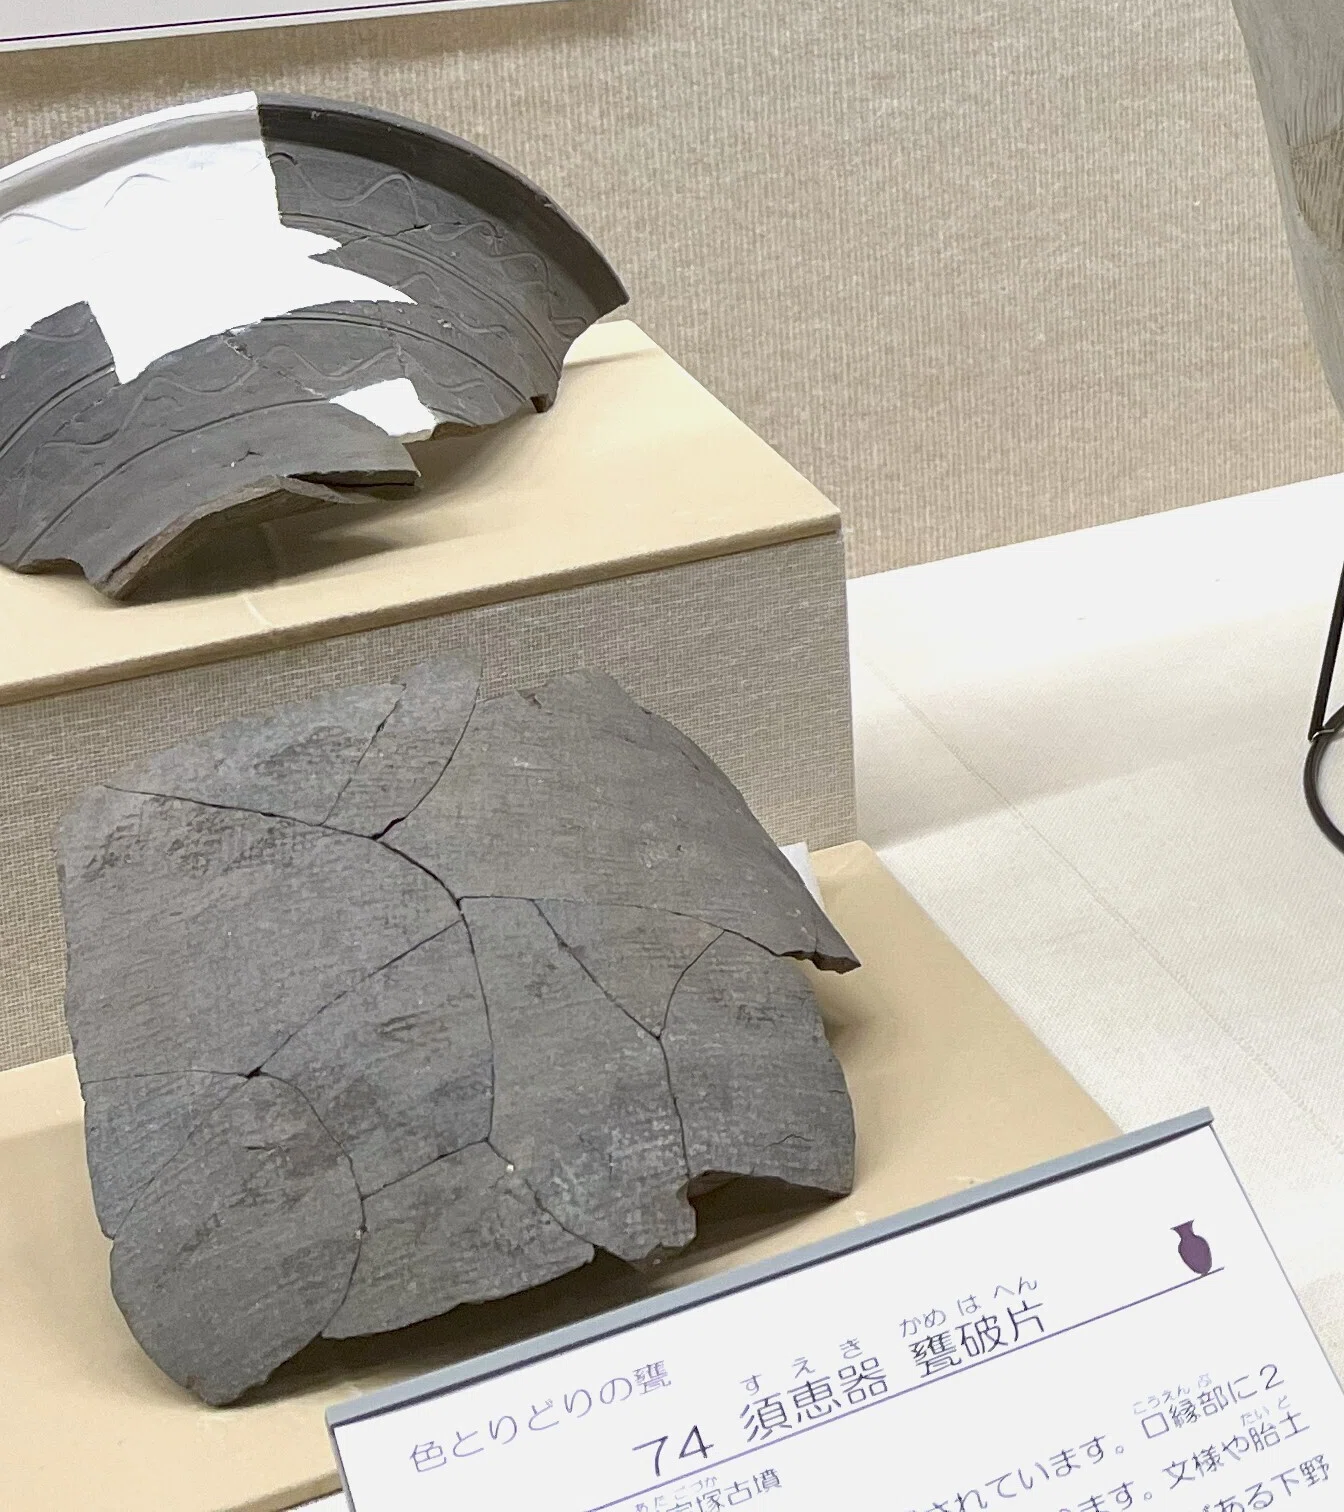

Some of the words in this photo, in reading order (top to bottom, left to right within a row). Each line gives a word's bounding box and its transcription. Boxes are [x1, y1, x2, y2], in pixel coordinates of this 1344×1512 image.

[409, 1360, 672, 1473] 色とりどりの甕
[632, 1424, 714, 1478] 74
[738, 1355, 888, 1443] 須恵器
[909, 1300, 1046, 1379] 甕破片
